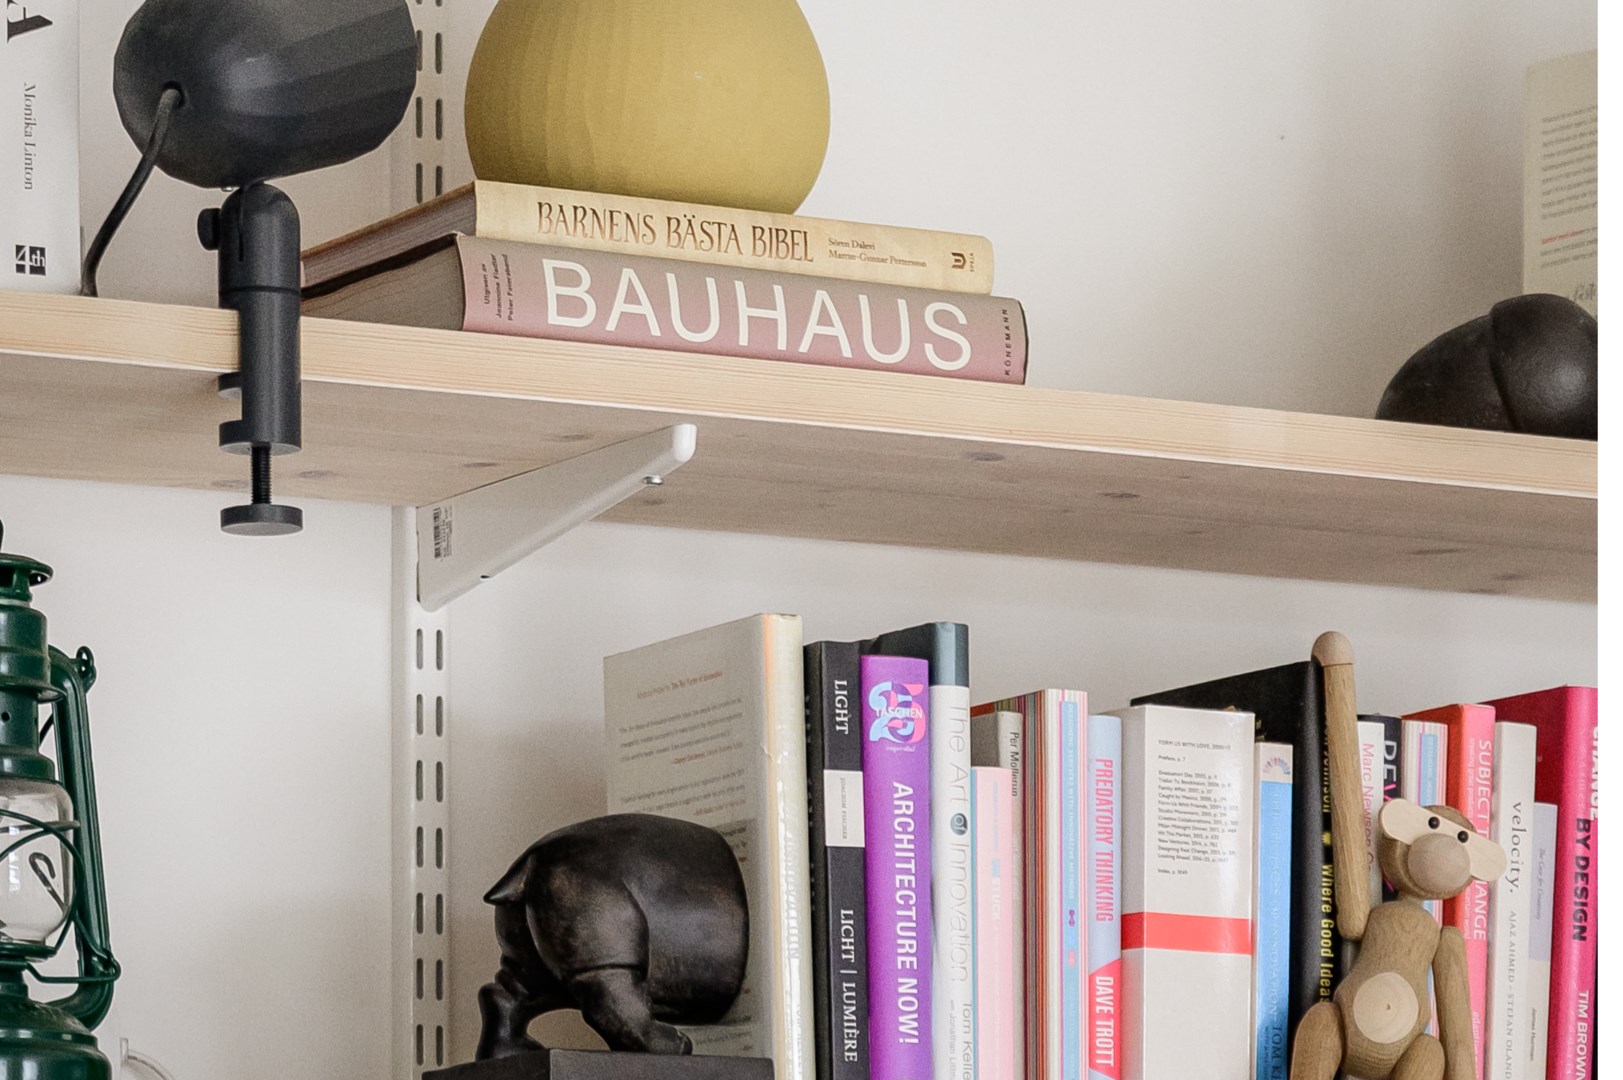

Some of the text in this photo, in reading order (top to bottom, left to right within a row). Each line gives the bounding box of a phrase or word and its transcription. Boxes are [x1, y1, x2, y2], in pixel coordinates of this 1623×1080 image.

[24, 82, 37, 190] Monika Linton
[537, 201, 814, 263] BARNENS BÄSTA BIBEL
[828, 237, 876, 250] Sören Dalevi
[889, 255, 928, 268] Pettersson
[542, 258, 972, 371] BAUHAUS
[1002, 308, 1011, 377] KÖNEMANN
[834, 679, 850, 735] LIGHT
[876, 706, 923, 719] TASCHEN
[948, 705, 969, 753] The
[1010, 731, 1020, 745] Per
[949, 764, 969, 803] Art
[1475, 739, 1492, 825] SUBJECT
[1094, 758, 1114, 923] PREDATORY THINKING
[1505, 801, 1528, 894] velocity.
[893, 781, 919, 970] ARCHITECTURE
[1321, 863, 1334, 913] Where
[1572, 817, 1591, 942] BY DESIGN
[949, 842, 973, 982] Innovation
[1319, 919, 1334, 957] Good
[1508, 910, 1518, 940] AJAZ
[840, 909, 858, 1062] LICHT LUMIÈRE
[1507, 942, 1517, 983] AHMED
[896, 977, 920, 1045] NOW!
[962, 1002, 972, 1034] Tom
[1095, 975, 1114, 1068] DAVE TROTT
[1505, 993, 1515, 1037] STEFAN
[1577, 990, 1589, 1018] TIM
